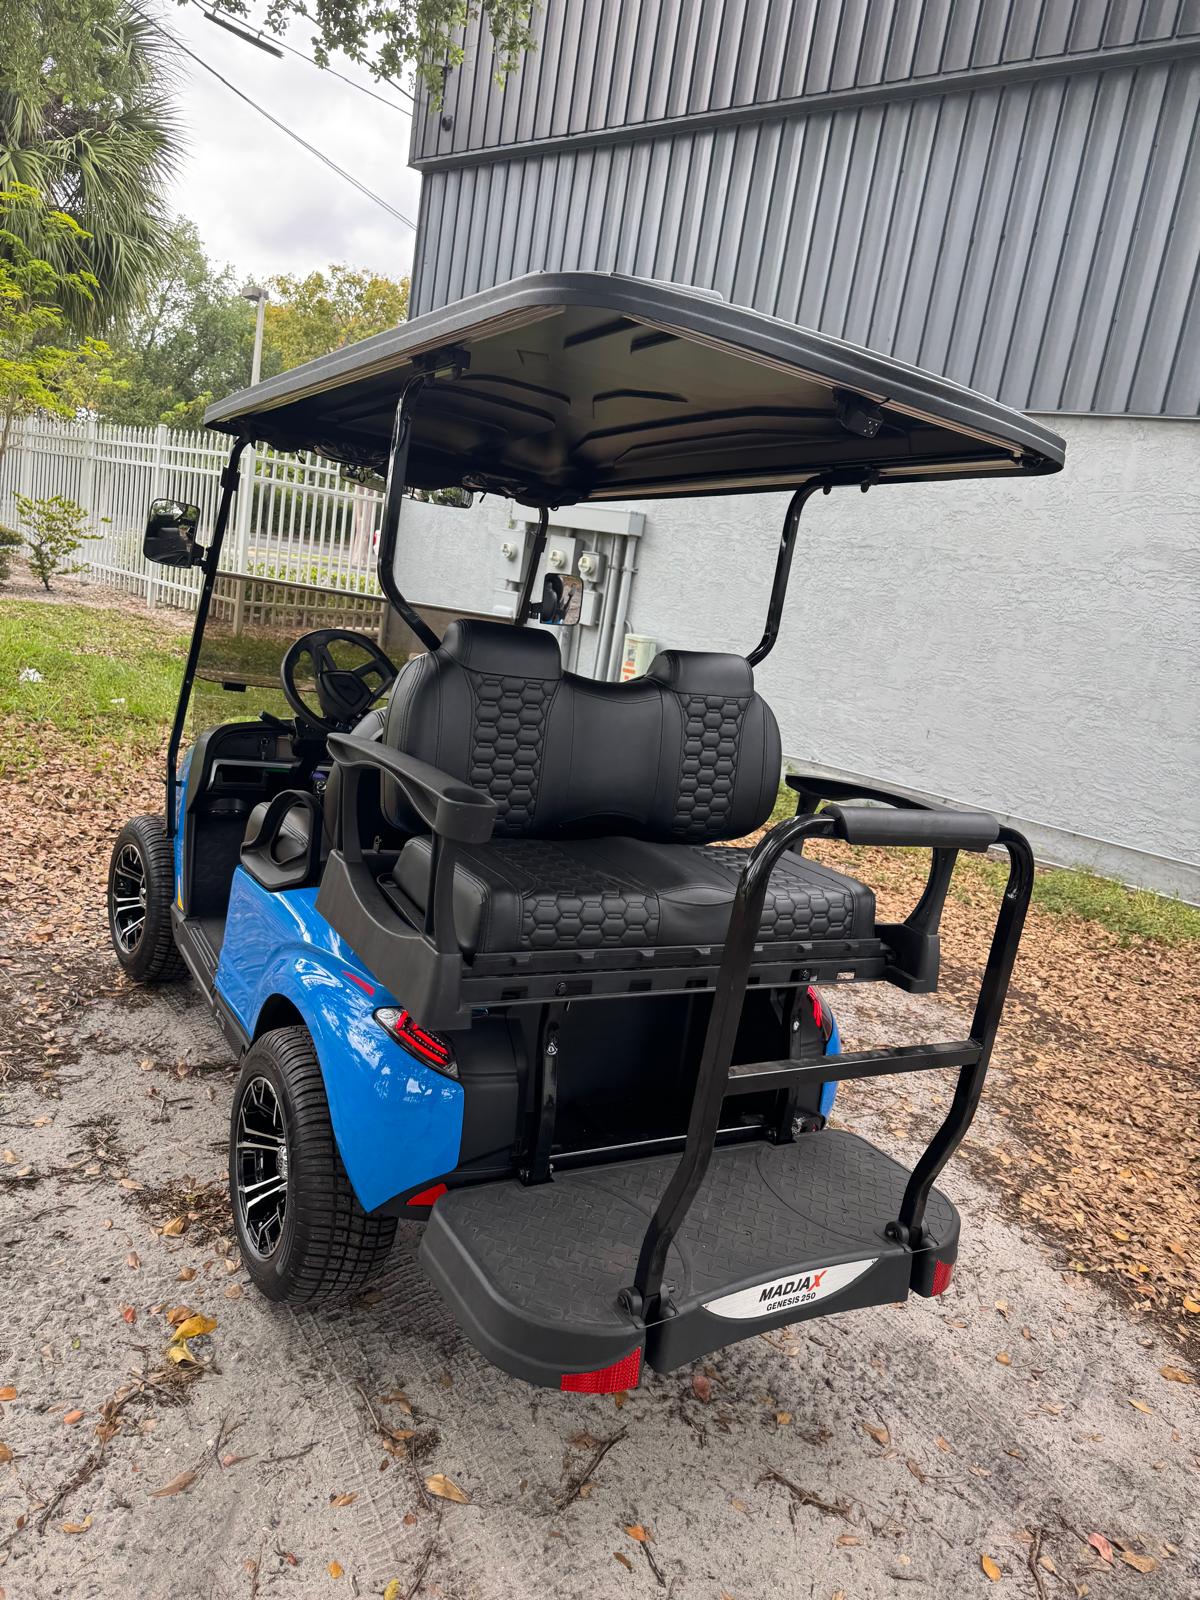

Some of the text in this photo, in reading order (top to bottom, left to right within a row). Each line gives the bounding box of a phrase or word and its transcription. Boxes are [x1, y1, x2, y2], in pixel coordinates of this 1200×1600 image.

[759, 1270, 827, 1303] MADJAX
[766, 1292, 816, 1311] GENESIS 250
